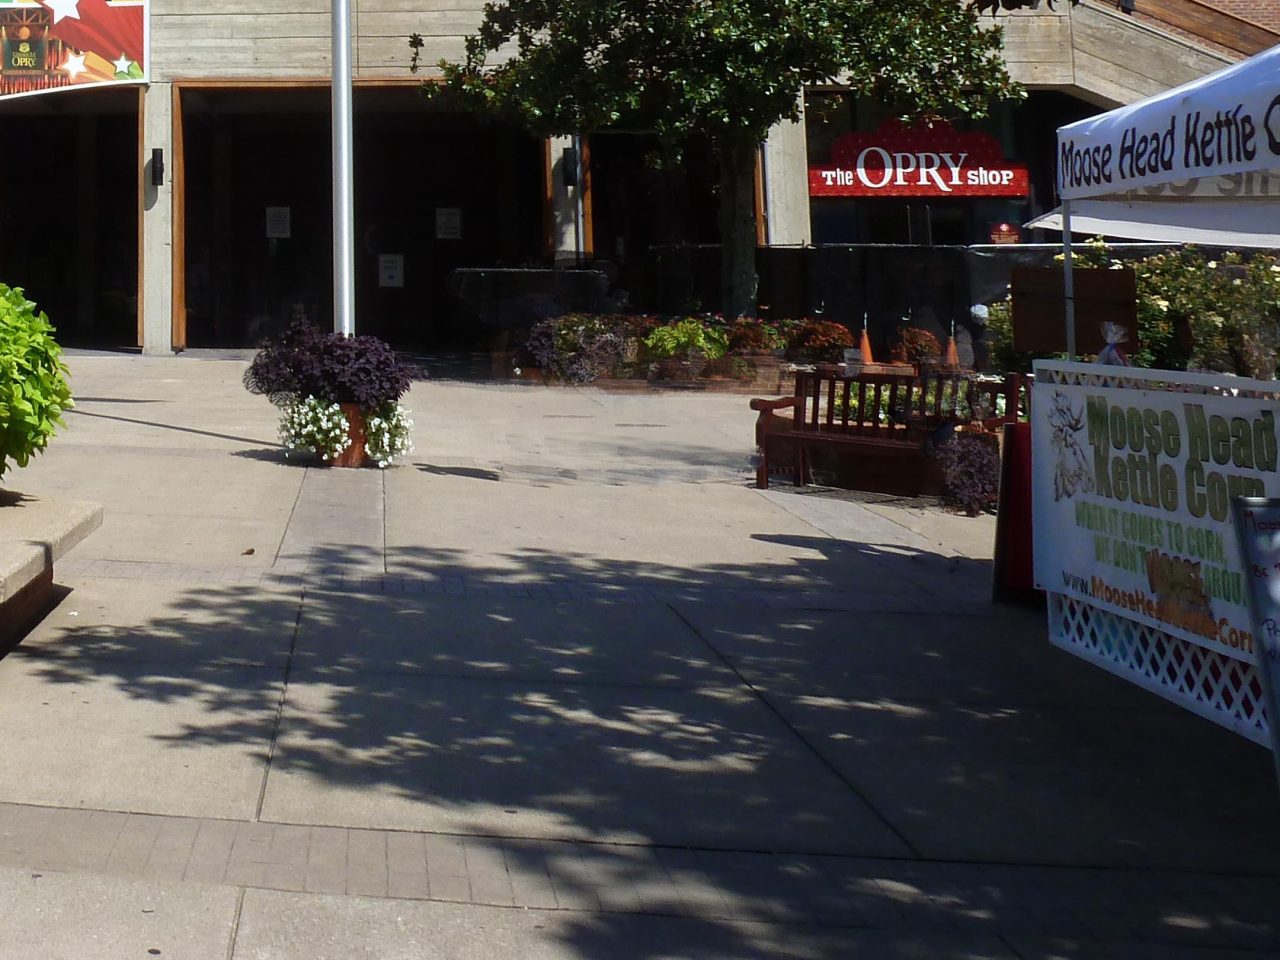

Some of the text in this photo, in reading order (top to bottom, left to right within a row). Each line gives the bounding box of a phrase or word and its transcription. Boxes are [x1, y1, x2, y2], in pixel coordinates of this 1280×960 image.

[11, 56, 37, 68] OPRY
[822, 168, 854, 186] The
[856, 147, 968, 192] OPRY
[1061, 140, 1113, 189] Moose
[1119, 116, 1176, 179] Head
[1184, 104, 1256, 168] Kettle
[1086, 395, 1277, 472] Moose Head
[1094, 444, 1179, 512] Kettle
